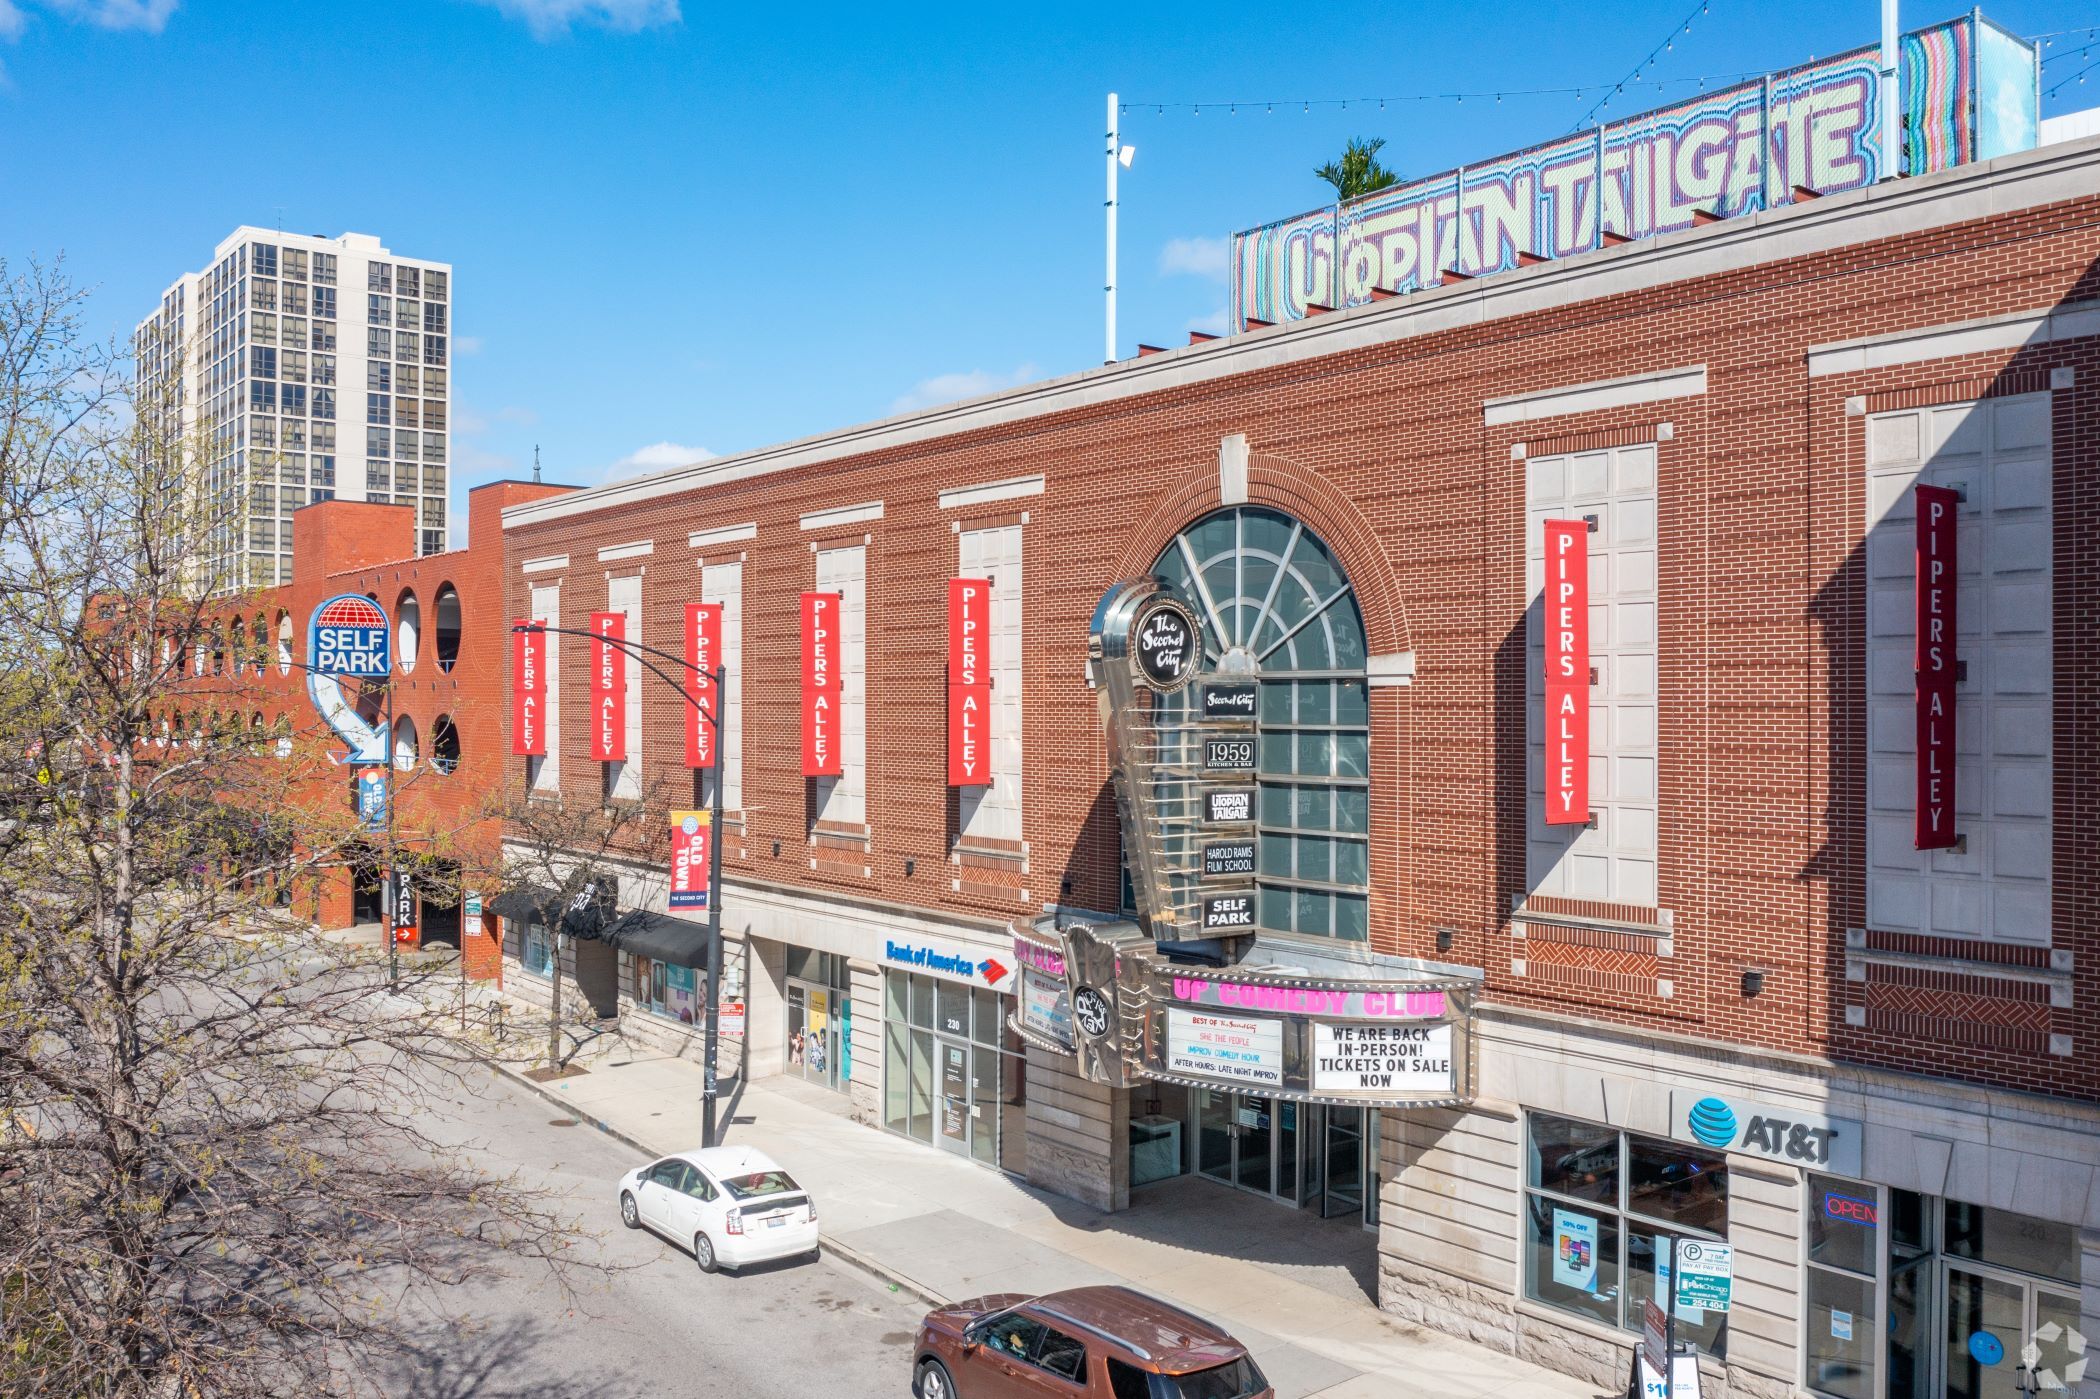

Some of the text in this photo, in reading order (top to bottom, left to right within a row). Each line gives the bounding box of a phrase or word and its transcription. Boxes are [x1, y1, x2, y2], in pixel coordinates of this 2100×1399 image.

[1290, 83, 1862, 314] UTOPIAN TAILGATE
[1152, 615, 1177, 633] The
[318, 629, 384, 651] SELF
[1142, 629, 1184, 650] Second
[318, 651, 386, 672] PARK
[1156, 649, 1182, 676] City
[1929, 502, 1943, 831] PIPERS ALLEY
[963, 587, 977, 777] PIPERS ALLEY
[1559, 534, 1575, 811] PIPERS ALLEY
[697, 611, 709, 761] PIPERS ALLEY
[814, 600, 828, 767] PIPERS ALLEY
[1207, 692, 1254, 711] Second City
[524, 697, 535, 750] ALLEY
[602, 697, 614, 754] ALLEY
[1209, 743, 1250, 761] 1959
[1212, 794, 1248, 807] UTOPIAN
[1212, 806, 1248, 819] TAILGATE
[690, 835, 704, 865] OLD
[1207, 846, 1253, 859] HAROLD RAMIS
[675, 846, 690, 890] TOWN
[1207, 859, 1253, 872] FILM SCHOOL
[400, 875, 411, 926] PARK
[1213, 899, 1247, 912] SELF
[1208, 911, 1251, 926] PARK
[886, 940, 974, 977] Bank of America
[1173, 976, 1446, 1017] UP COMEDY CLUB
[947, 1018, 960, 1030] 230
[1192, 1016, 1207, 1025] BEST
[1209, 1018, 1217, 1026] OF
[1200, 1032, 1250, 1047] SHE THE PEOPLE
[1333, 1028, 1430, 1041] WE ARE BACK
[1187, 1045, 1260, 1063] IMPROV COMEDY HOUR
[1338, 1043, 1424, 1057] IN-PERSON!
[1174, 1058, 1278, 1080] AFTER HOURS: LATE NIGHT IMPROV
[1320, 1058, 1449, 1073] TICKETS ON SALE
[1360, 1075, 1392, 1087] NOW
[1740, 1115, 1838, 1165] AT&T
[1827, 1198, 1878, 1223] OPEN
[2020, 1222, 2046, 1240] 220
[1689, 1246, 1698, 1257] P
[1692, 1299, 1724, 1309] 254 404
